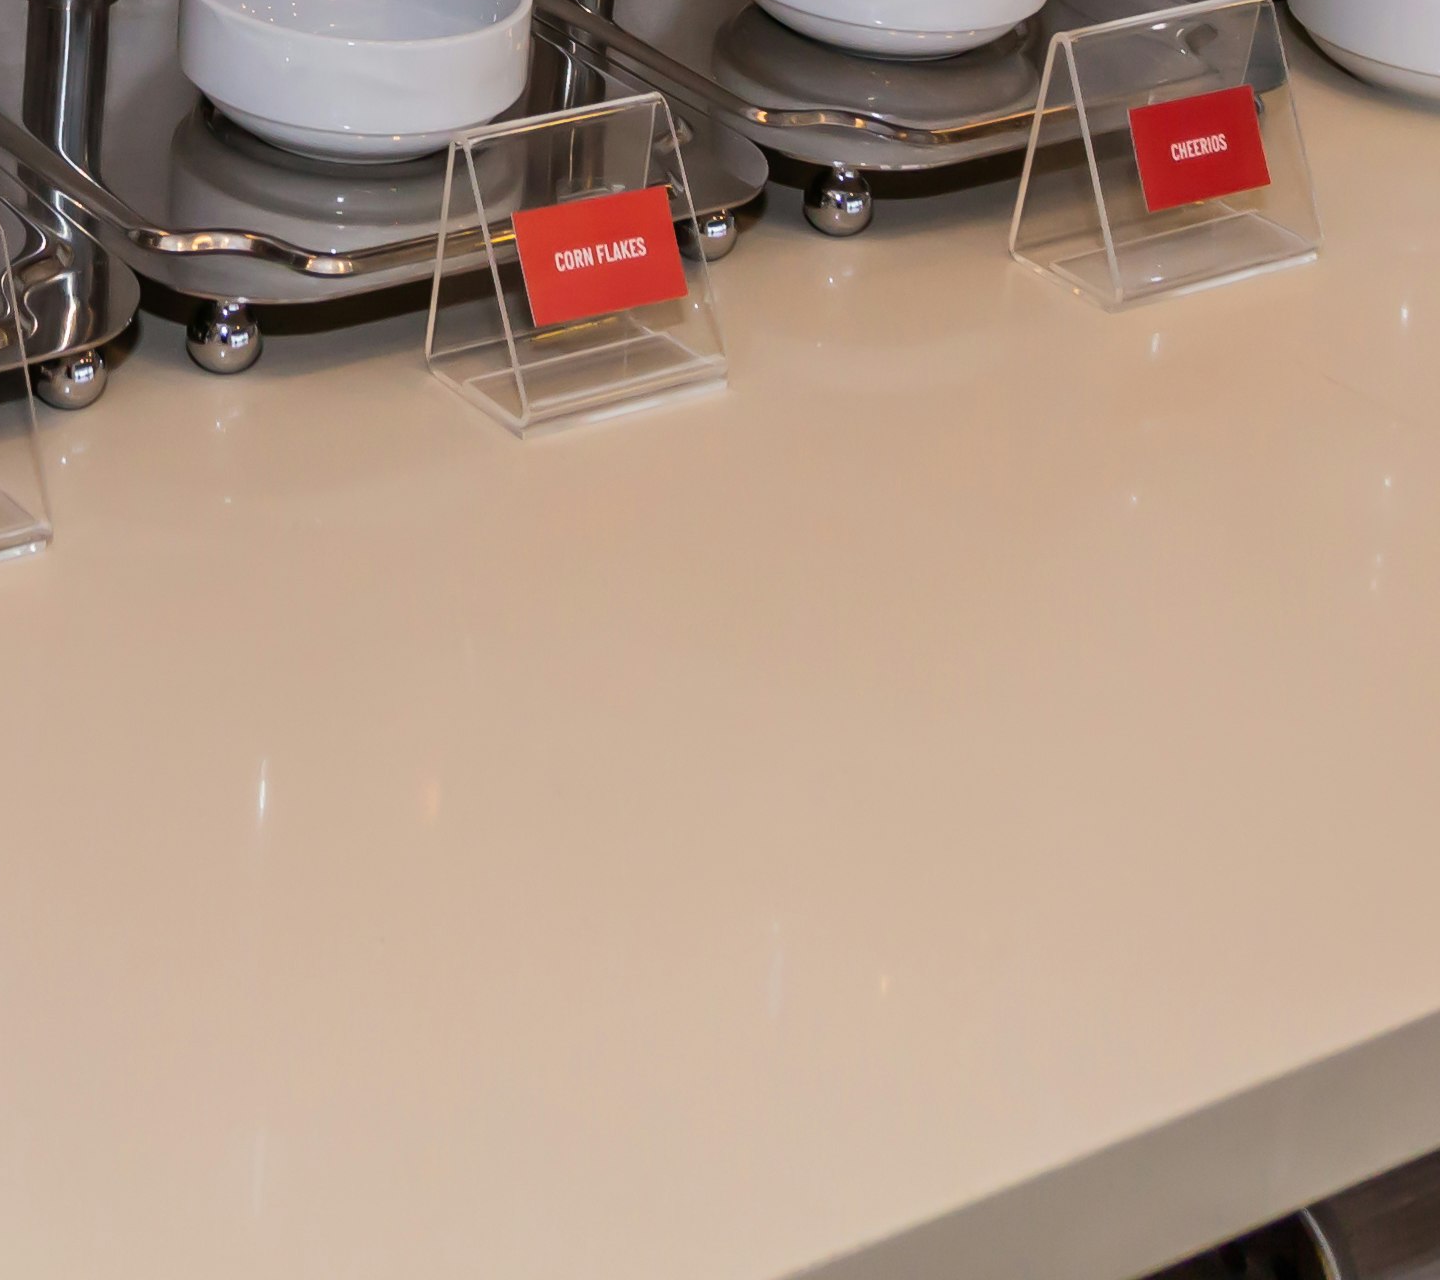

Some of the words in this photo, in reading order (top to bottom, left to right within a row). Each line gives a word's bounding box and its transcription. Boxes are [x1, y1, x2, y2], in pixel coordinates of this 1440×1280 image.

[1171, 134, 1228, 161] CHEERIOS
[555, 247, 594, 272] CORN
[596, 237, 647, 264] FLAKES
